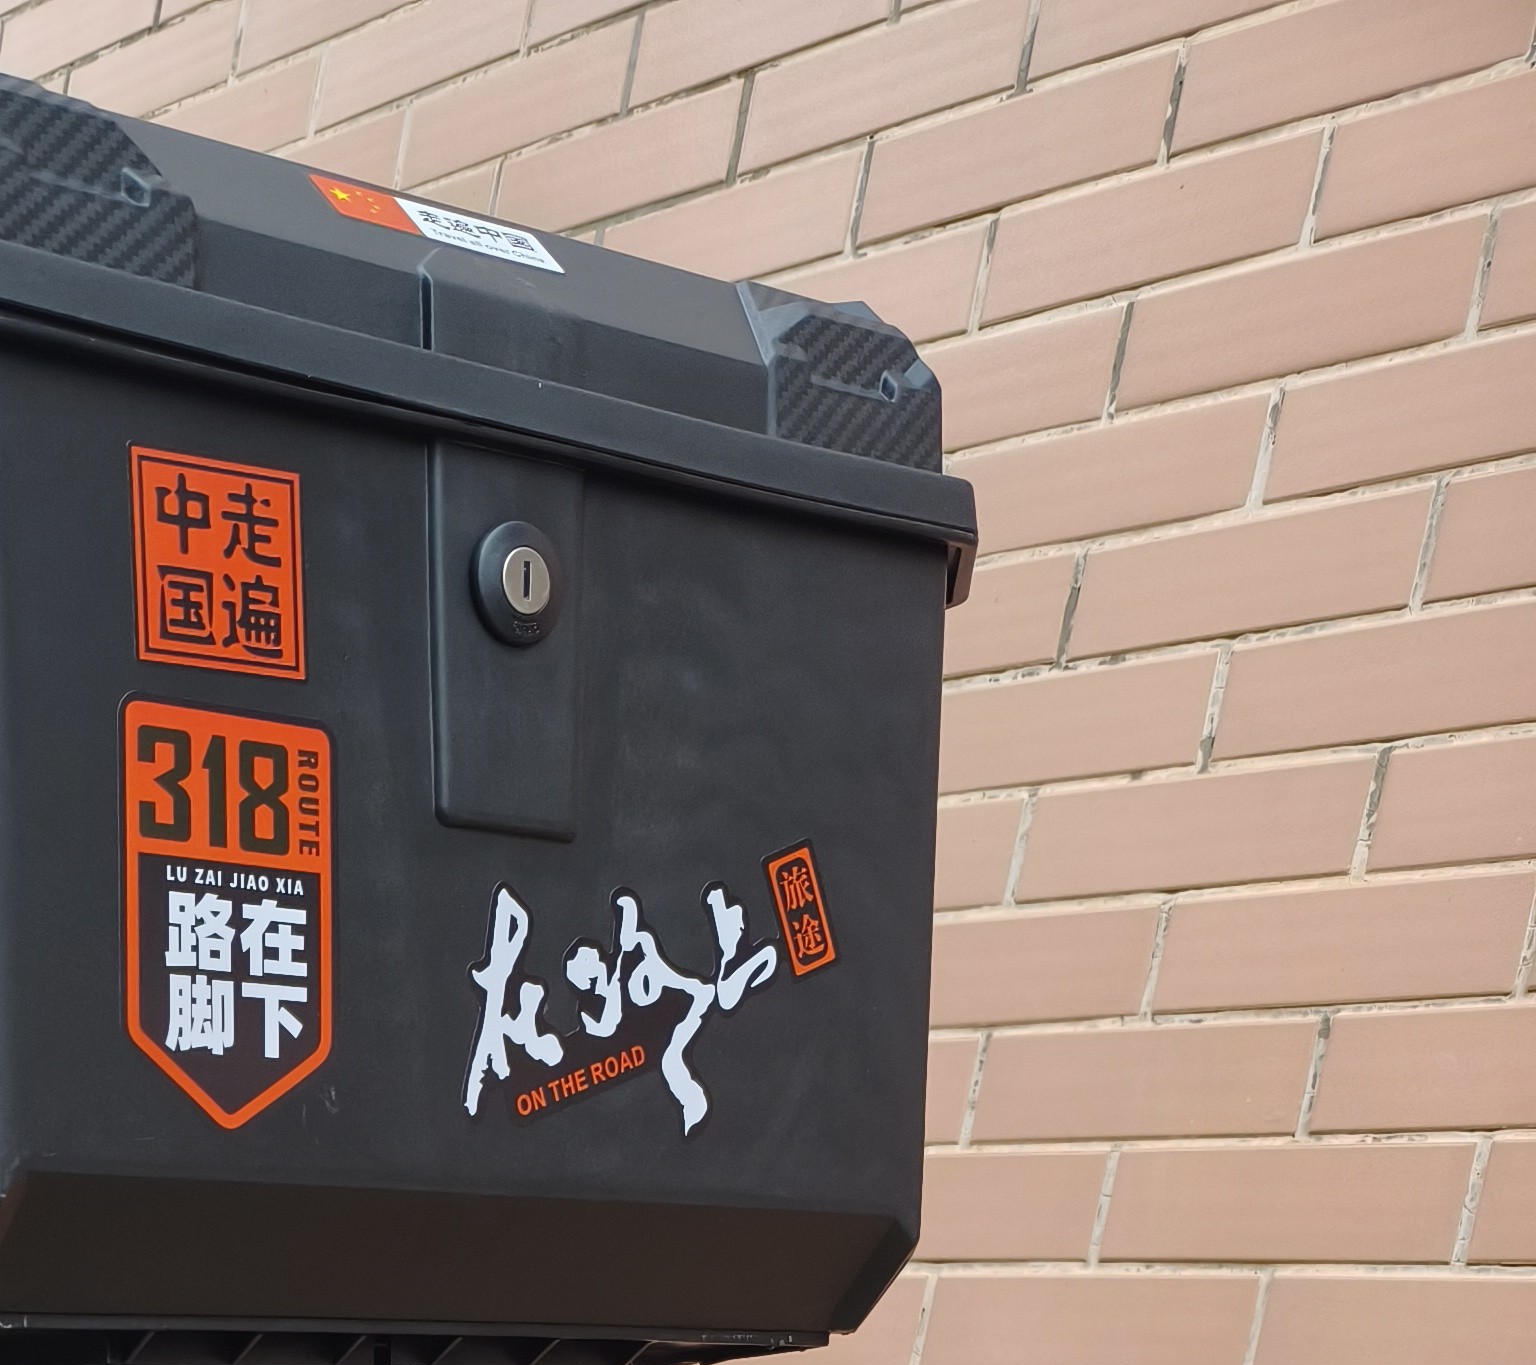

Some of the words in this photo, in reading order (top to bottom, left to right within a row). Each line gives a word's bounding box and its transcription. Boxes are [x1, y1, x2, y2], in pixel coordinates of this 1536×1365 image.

[417, 210, 538, 253] 走遍中国
[136, 723, 291, 858] 318
[296, 748, 321, 858] ROUTE
[166, 864, 188, 884] LU
[194, 867, 223, 888] ZAI
[229, 871, 270, 892] JIAO
[275, 876, 305, 897] XIA
[780, 865, 826, 960] 旅途
[515, 1086, 546, 1117] ON
[547, 1069, 590, 1103] THE
[590, 1044, 647, 1085] ROAD
